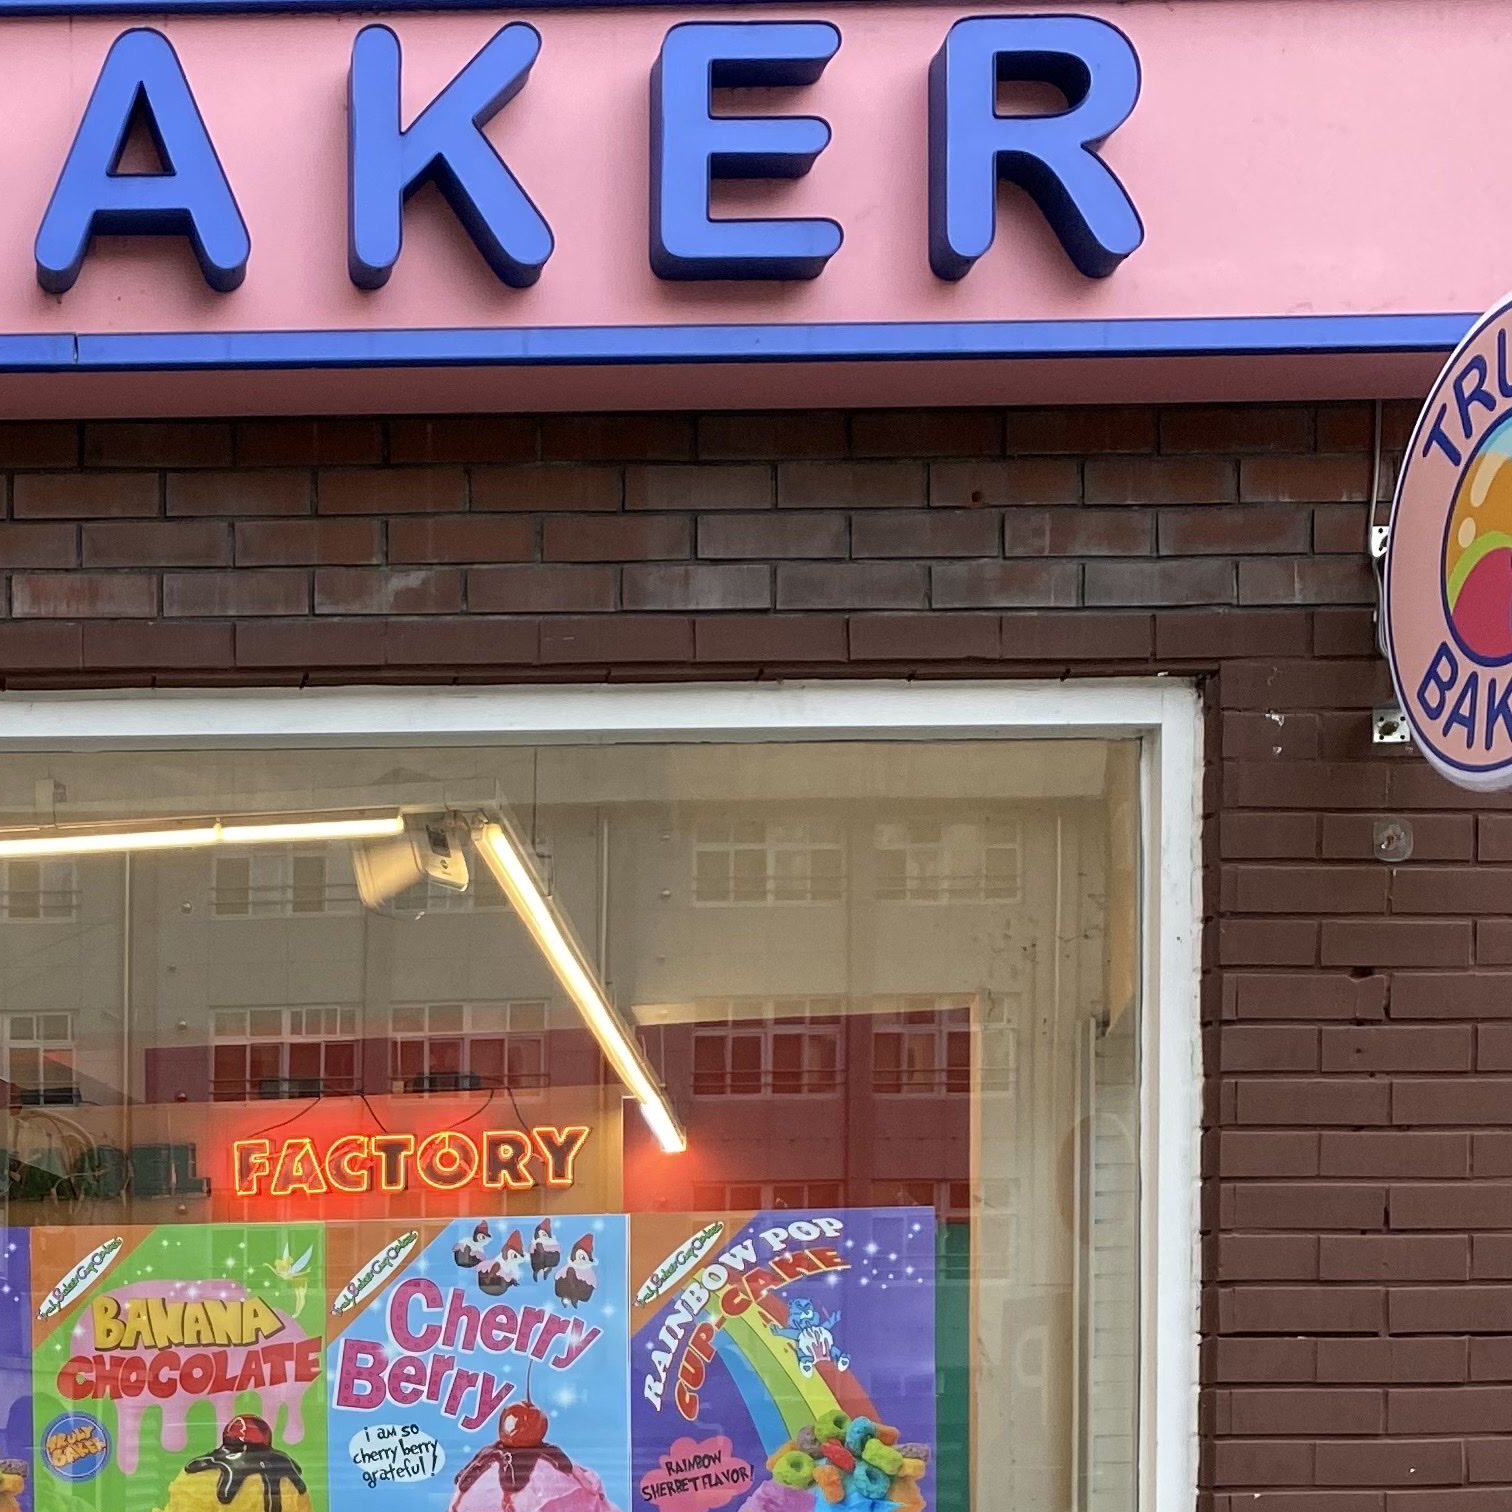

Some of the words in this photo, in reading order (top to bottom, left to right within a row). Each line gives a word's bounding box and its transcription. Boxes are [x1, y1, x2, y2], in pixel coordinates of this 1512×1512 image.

[233, 1126, 590, 1196] FACTORY
[92, 1295, 286, 1352] BANANA
[389, 1277, 601, 1368] Cherry
[644, 1239, 757, 1411] RAINBOW
[759, 1217, 843, 1251] POP
[56, 1336, 323, 1401] CHOCOLATE
[336, 1338, 516, 1430] Berry
[353, 1442, 398, 1464] cherry
[399, 1438, 438, 1458] berry
[401, 1424, 419, 1437] so
[665, 1450, 722, 1476] RAINBOW
[701, 1464, 755, 1489] FLAVOR!
